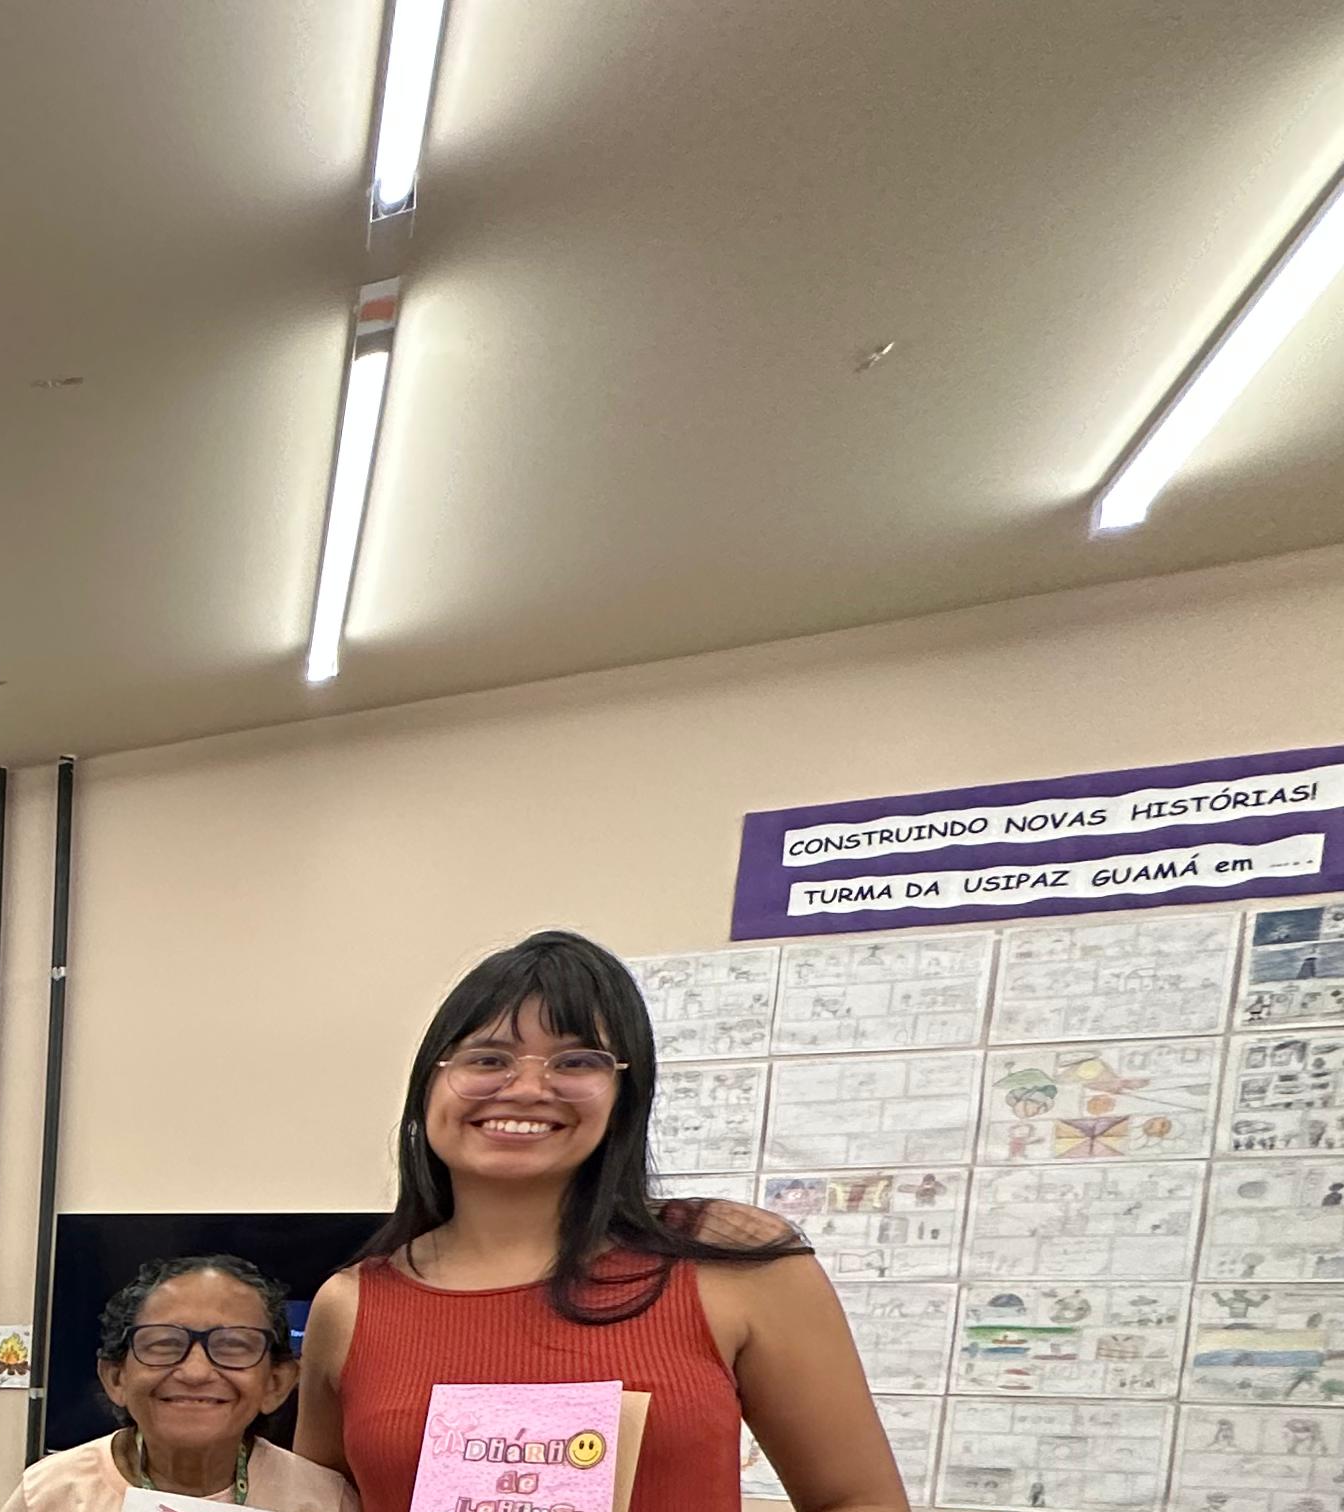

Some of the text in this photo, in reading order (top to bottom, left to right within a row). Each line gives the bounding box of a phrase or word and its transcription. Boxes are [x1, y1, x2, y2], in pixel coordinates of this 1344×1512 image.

[789, 782, 1318, 856] CONSTRUINDO NOVAS HISTÓRIAS!
[805, 884, 892, 905] TURMA
[905, 881, 940, 898] DA
[964, 870, 1071, 893] USIPAZ
[1092, 853, 1200, 887] GUAMÁ
[1215, 858, 1253, 873] em
[496, 1470, 541, 1495] de
